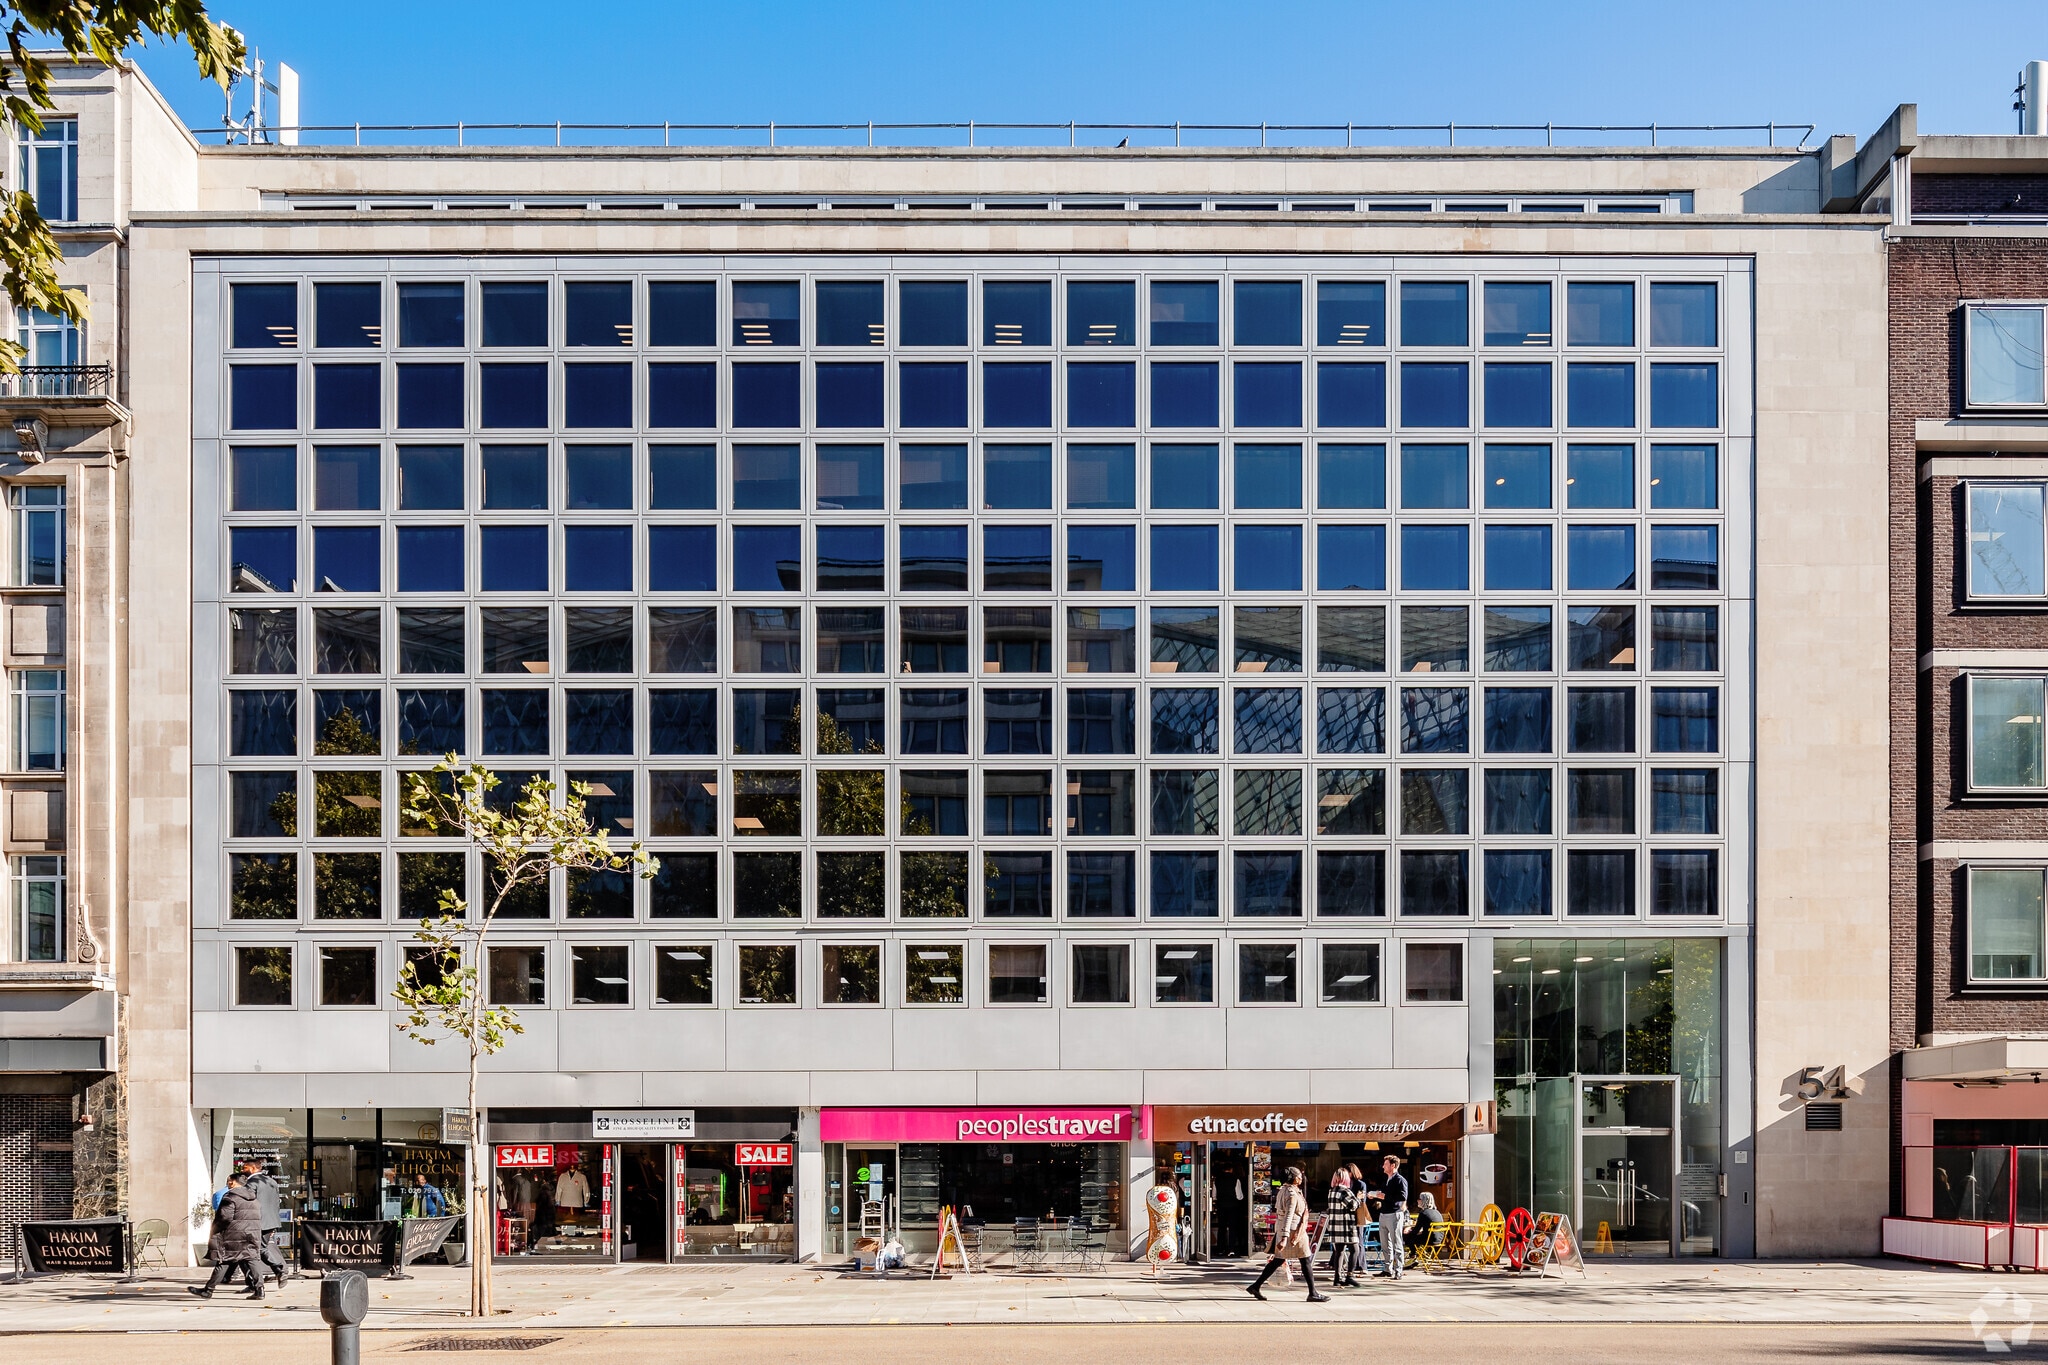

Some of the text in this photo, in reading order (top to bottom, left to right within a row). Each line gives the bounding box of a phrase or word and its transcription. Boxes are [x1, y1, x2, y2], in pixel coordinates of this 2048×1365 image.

[1798, 1065, 1850, 1100] 54
[452, 1116, 467, 1124] HAKIM
[614, 1118, 674, 1126] ROSSELINI
[1190, 1112, 1308, 1132] etnacoffee
[958, 1114, 1120, 1140] peoplestravel
[1327, 1120, 1428, 1134] sicilian street food
[406, 1150, 451, 1160] HAKIM
[501, 1148, 549, 1164] SALE
[740, 1147, 788, 1162] SALE
[49, 1232, 98, 1244] HAKIM
[325, 1229, 372, 1240] HAKIM
[42, 1245, 112, 1257] ELHOCINE
[313, 1243, 383, 1255] ELHOCINE
